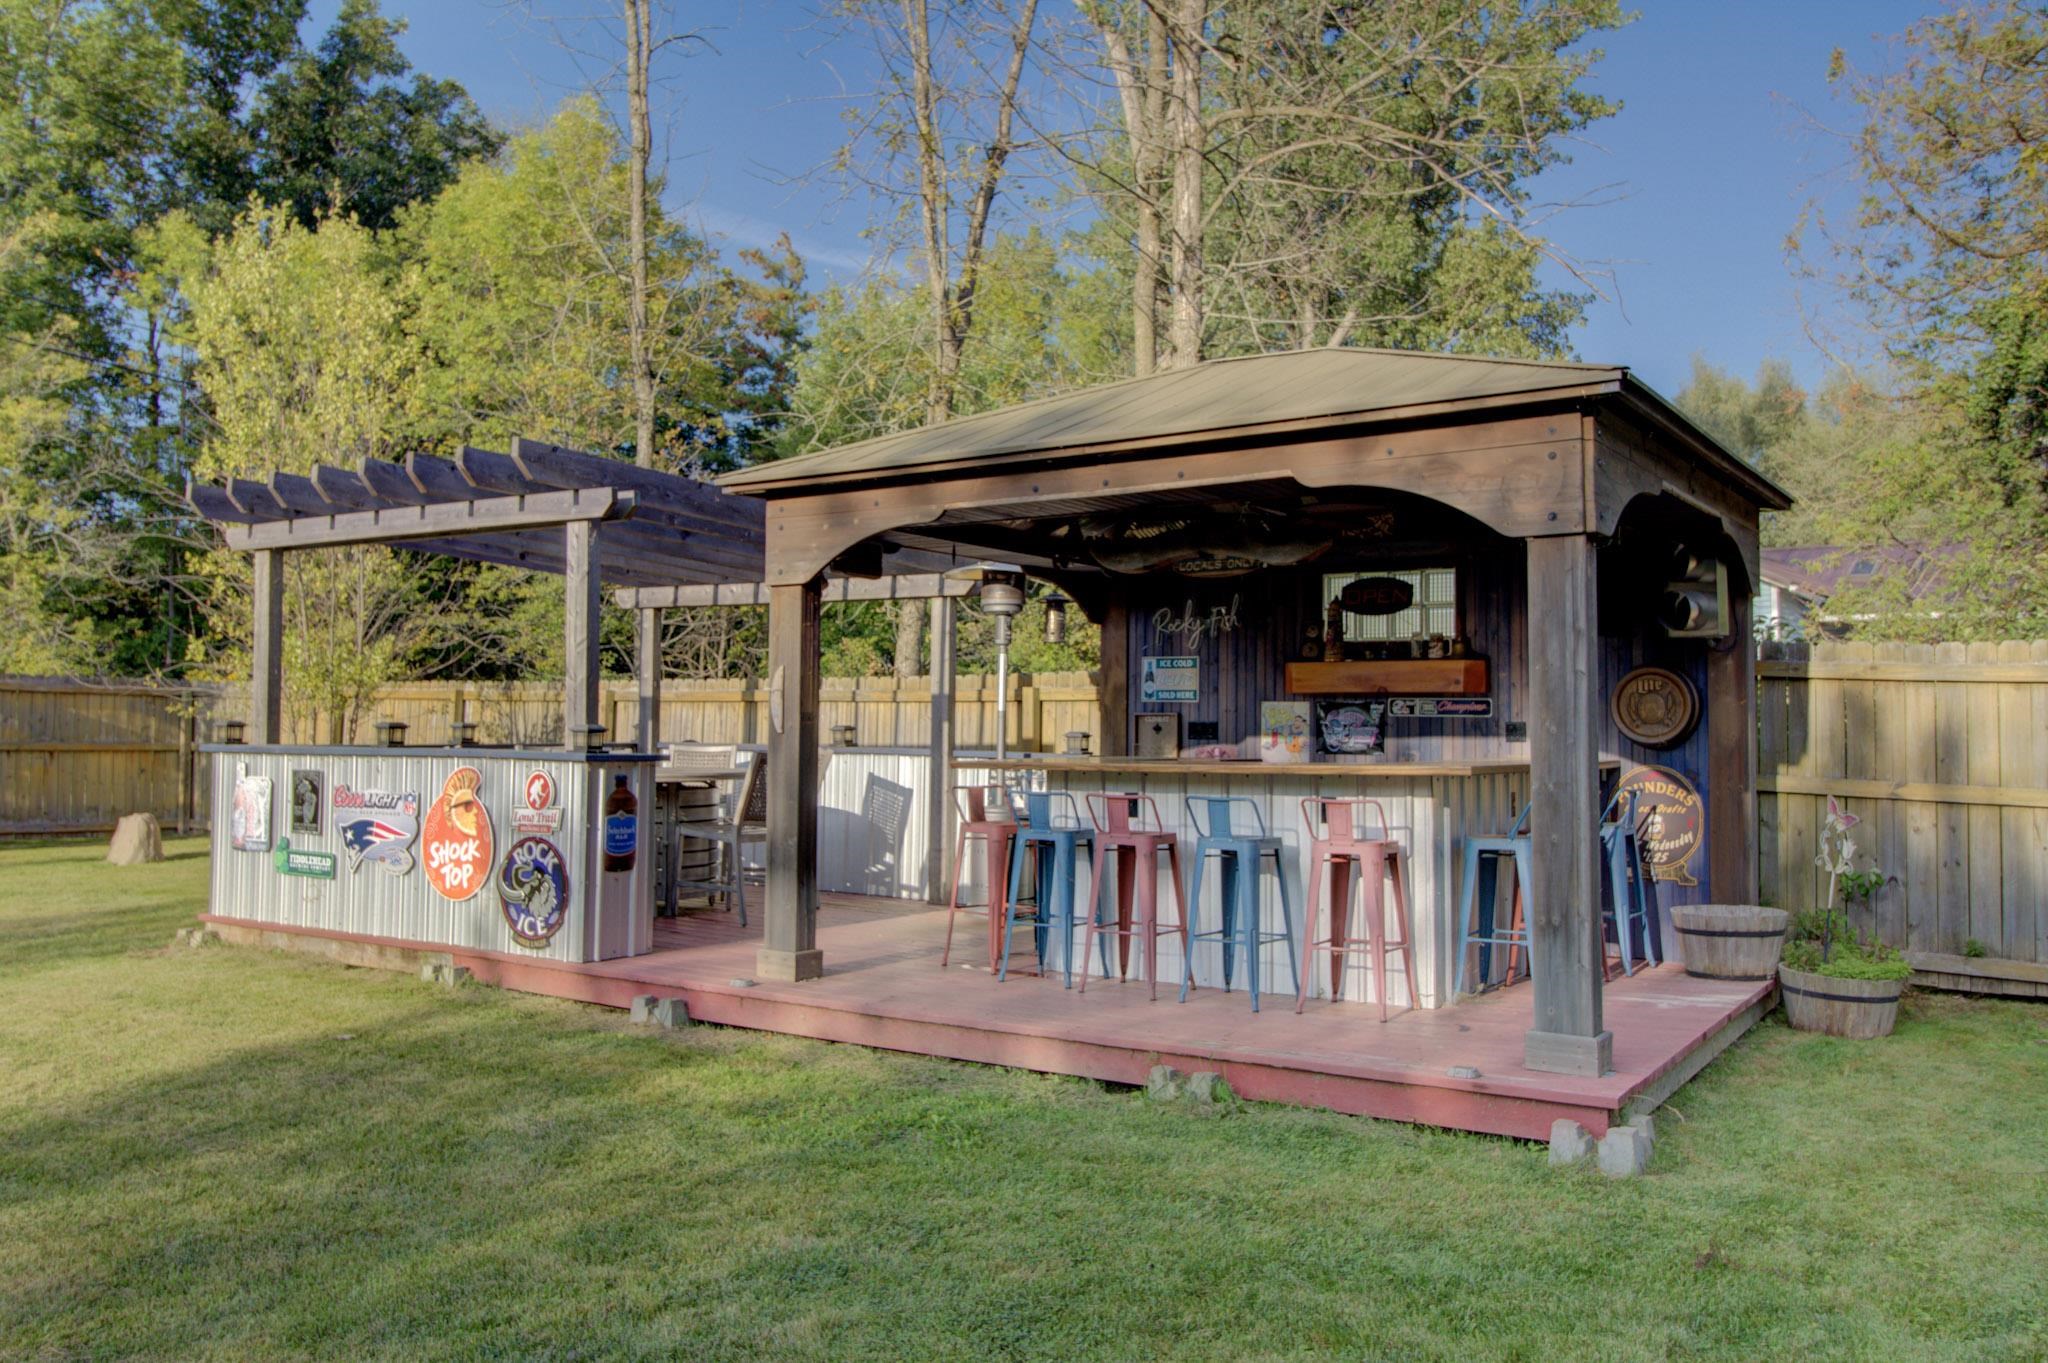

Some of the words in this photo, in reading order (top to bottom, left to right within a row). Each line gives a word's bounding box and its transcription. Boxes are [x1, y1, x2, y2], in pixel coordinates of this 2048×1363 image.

[1179, 560, 1222, 573] LOCALS
[1227, 559, 1254, 569] ONLY
[1345, 588, 1408, 605] OPEN
[1152, 599, 1206, 650] Rocky
[1210, 593, 1242, 639] Fish
[1172, 659, 1193, 667] COLD
[1158, 691, 1176, 699] SOLD
[1176, 691, 1194, 699] HERE
[335, 784, 365, 807] Coors
[364, 791, 402, 809] LIGHT
[512, 811, 534, 825] Long
[535, 810, 557, 824] Trail
[429, 838, 481, 869] SHOCK
[513, 841, 560, 874] ROCK
[440, 862, 474, 889] TOP
[516, 913, 547, 936] ICE
